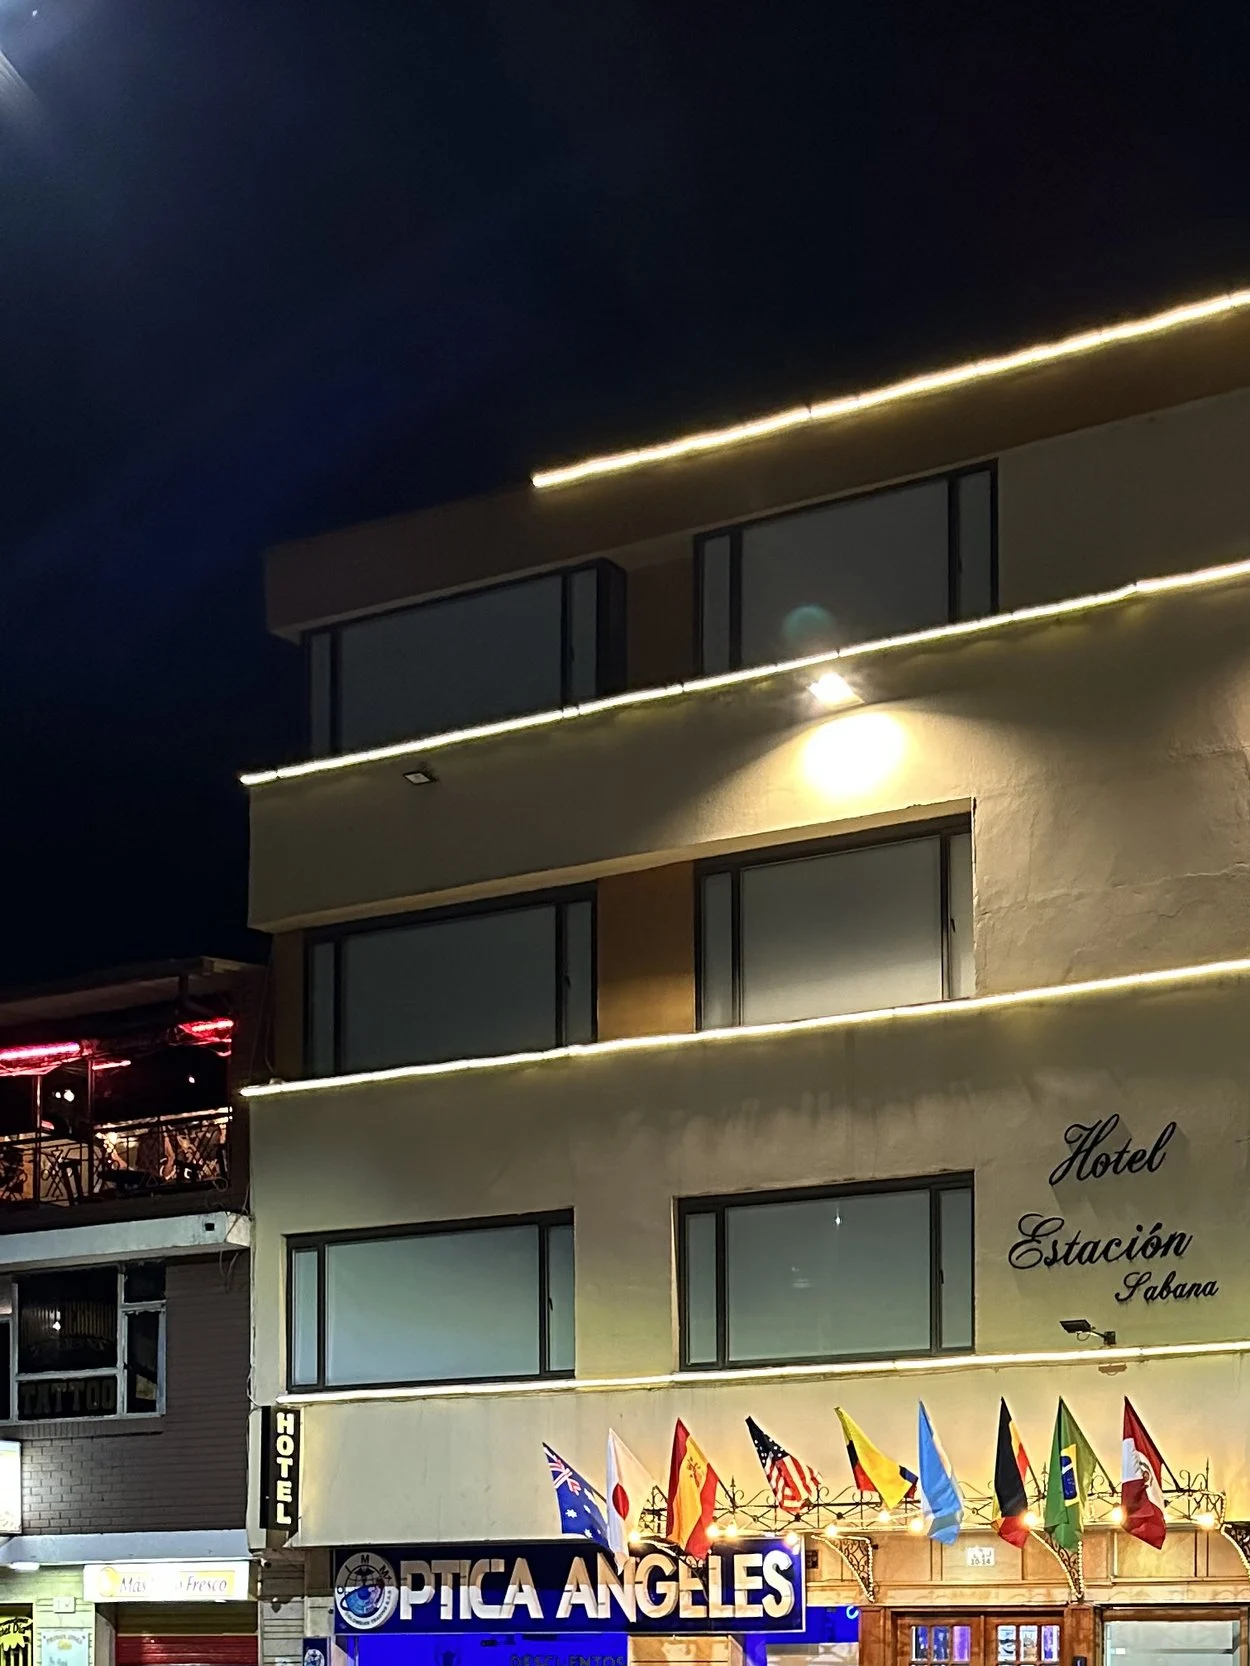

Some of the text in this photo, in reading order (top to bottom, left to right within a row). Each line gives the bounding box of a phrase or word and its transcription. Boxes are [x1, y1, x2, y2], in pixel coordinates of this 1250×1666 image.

[1048, 1113, 1177, 1186] Hotel
[1008, 1213, 1193, 1269] Estación
[1114, 1270, 1219, 1303] Sabana
[20, 1378, 116, 1414] TATTOO
[276, 1413, 294, 1525] HOTEL
[186, 1575, 228, 1593] Fresco
[556, 1550, 795, 1623] ANGELES
